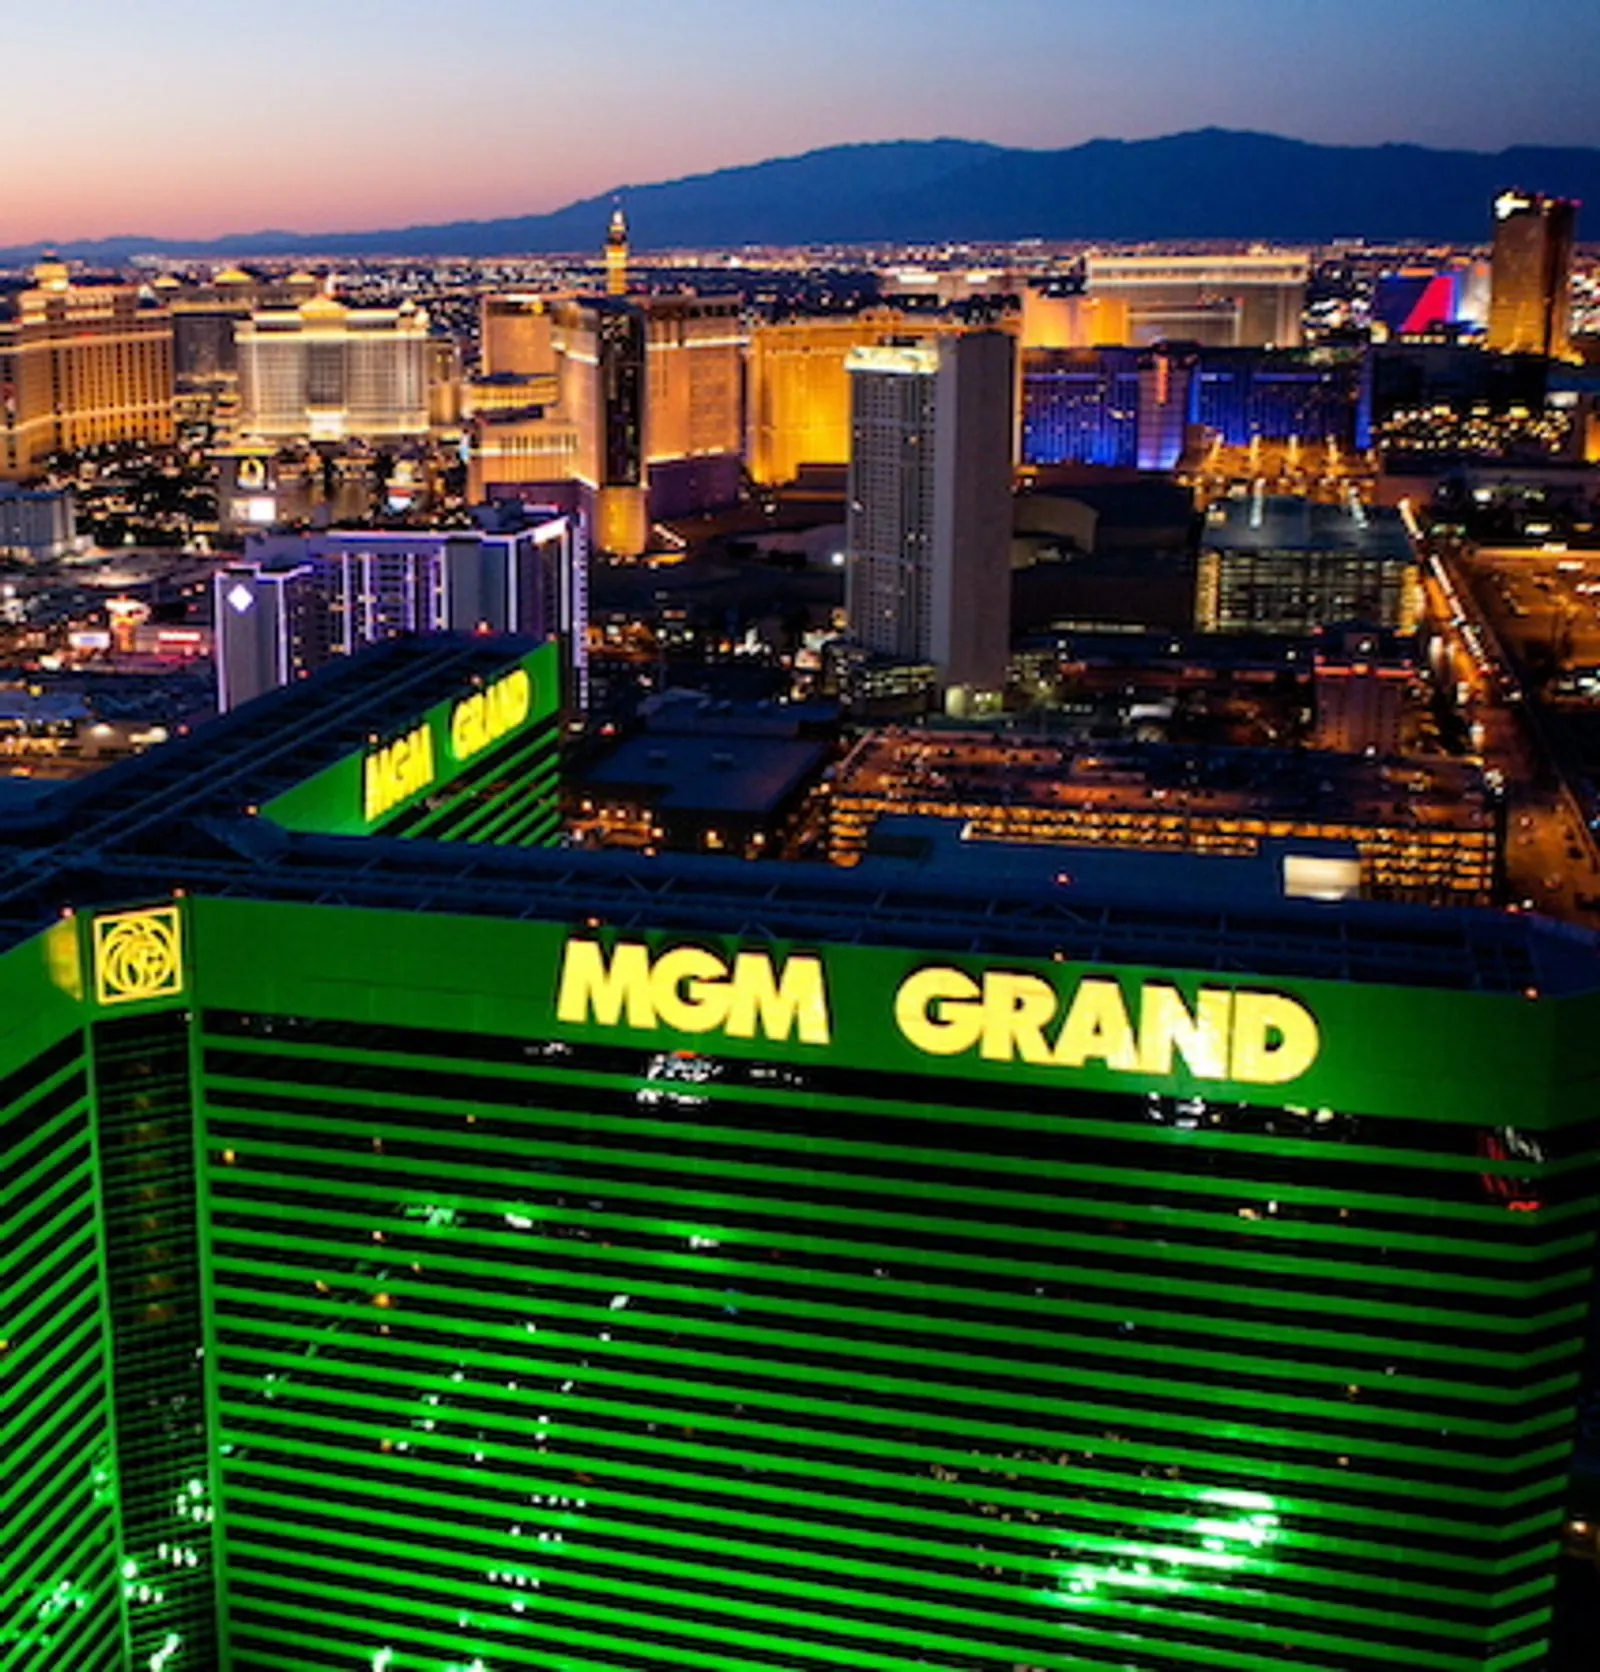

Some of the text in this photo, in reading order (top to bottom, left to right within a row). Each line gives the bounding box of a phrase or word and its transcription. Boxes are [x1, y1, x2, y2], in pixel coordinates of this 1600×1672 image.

[365, 669, 529, 822] MGM GRAND
[557, 939, 1320, 1084] MGM GRAND
